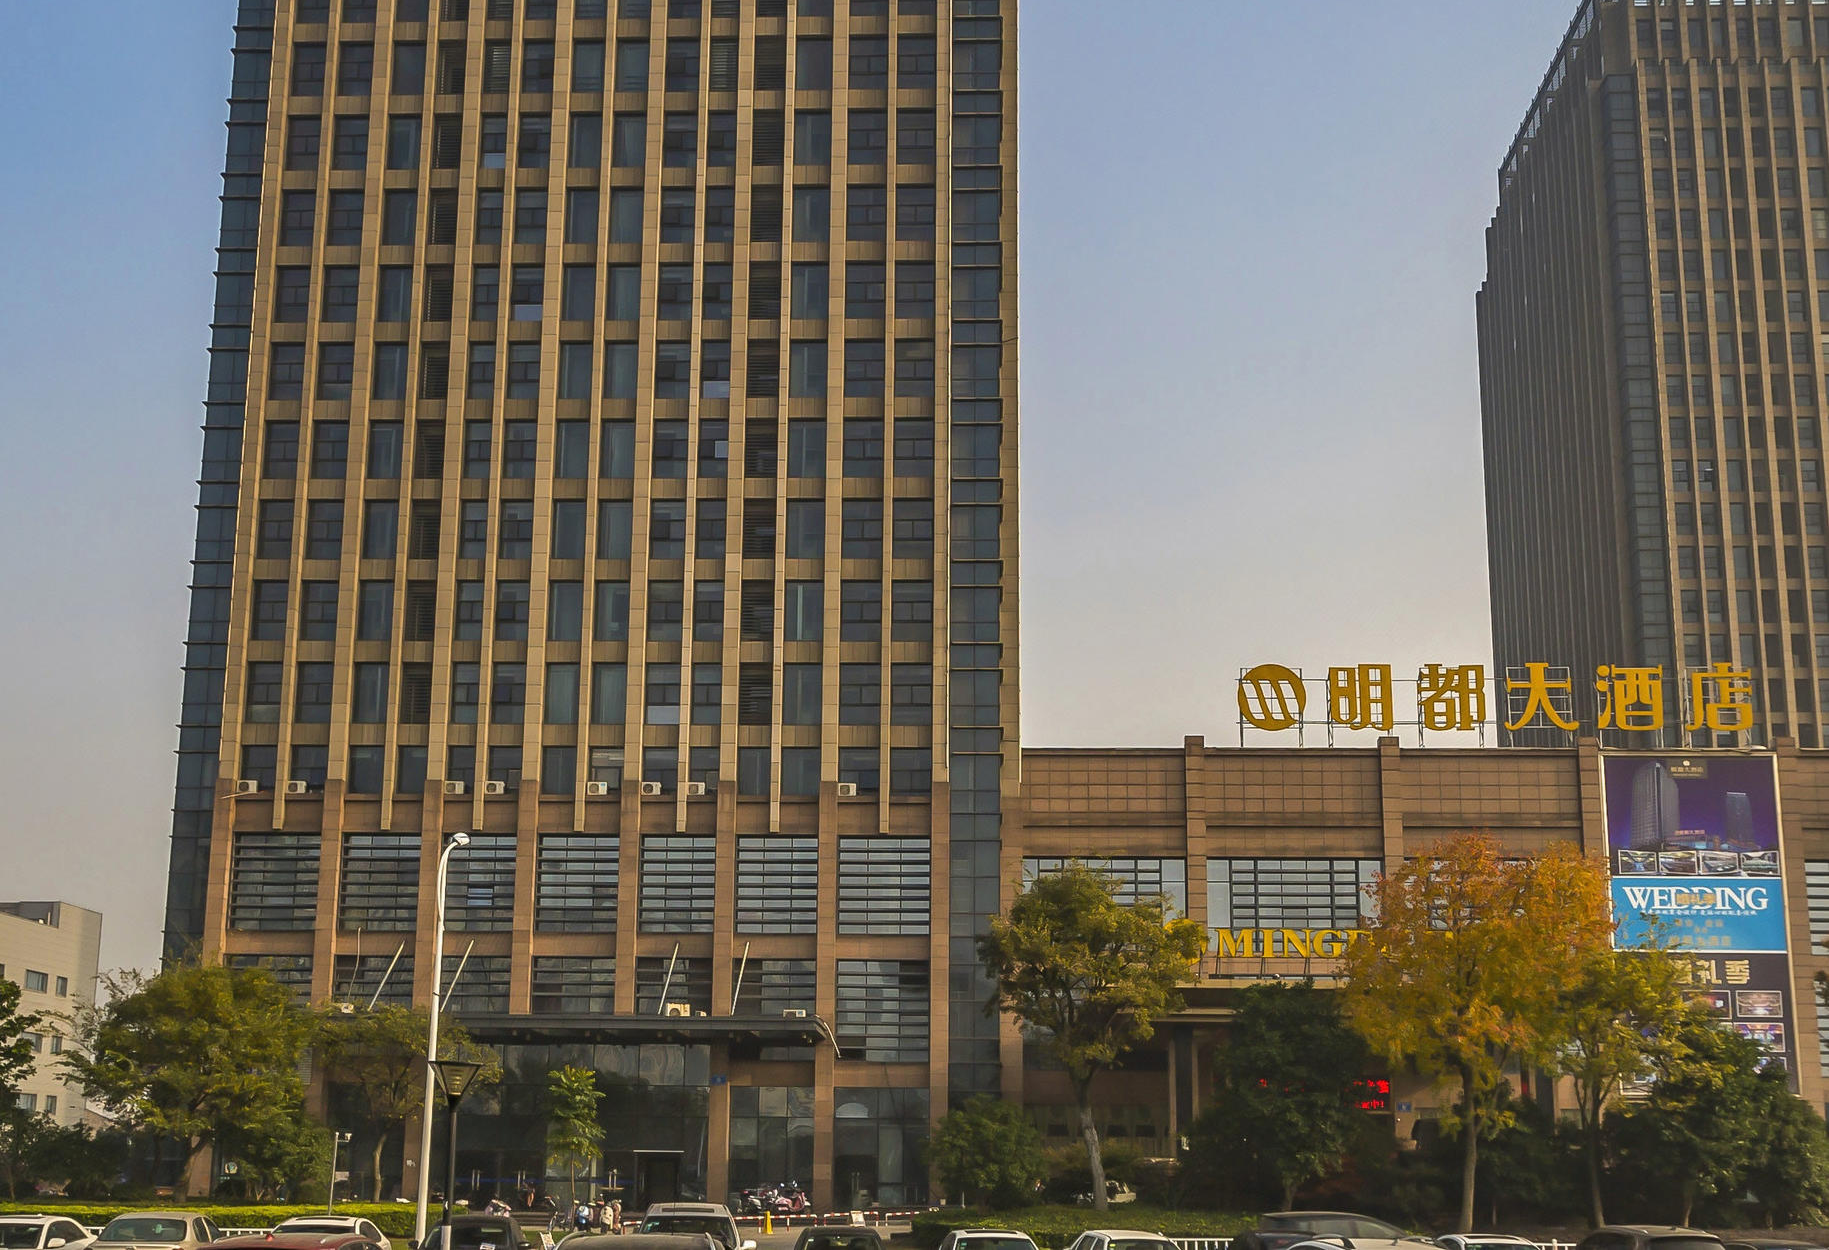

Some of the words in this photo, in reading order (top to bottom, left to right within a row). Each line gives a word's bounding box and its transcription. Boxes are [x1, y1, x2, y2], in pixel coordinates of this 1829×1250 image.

[1327, 662, 1752, 732] 明都大酒店
[1622, 886, 1769, 910] WEDDING
